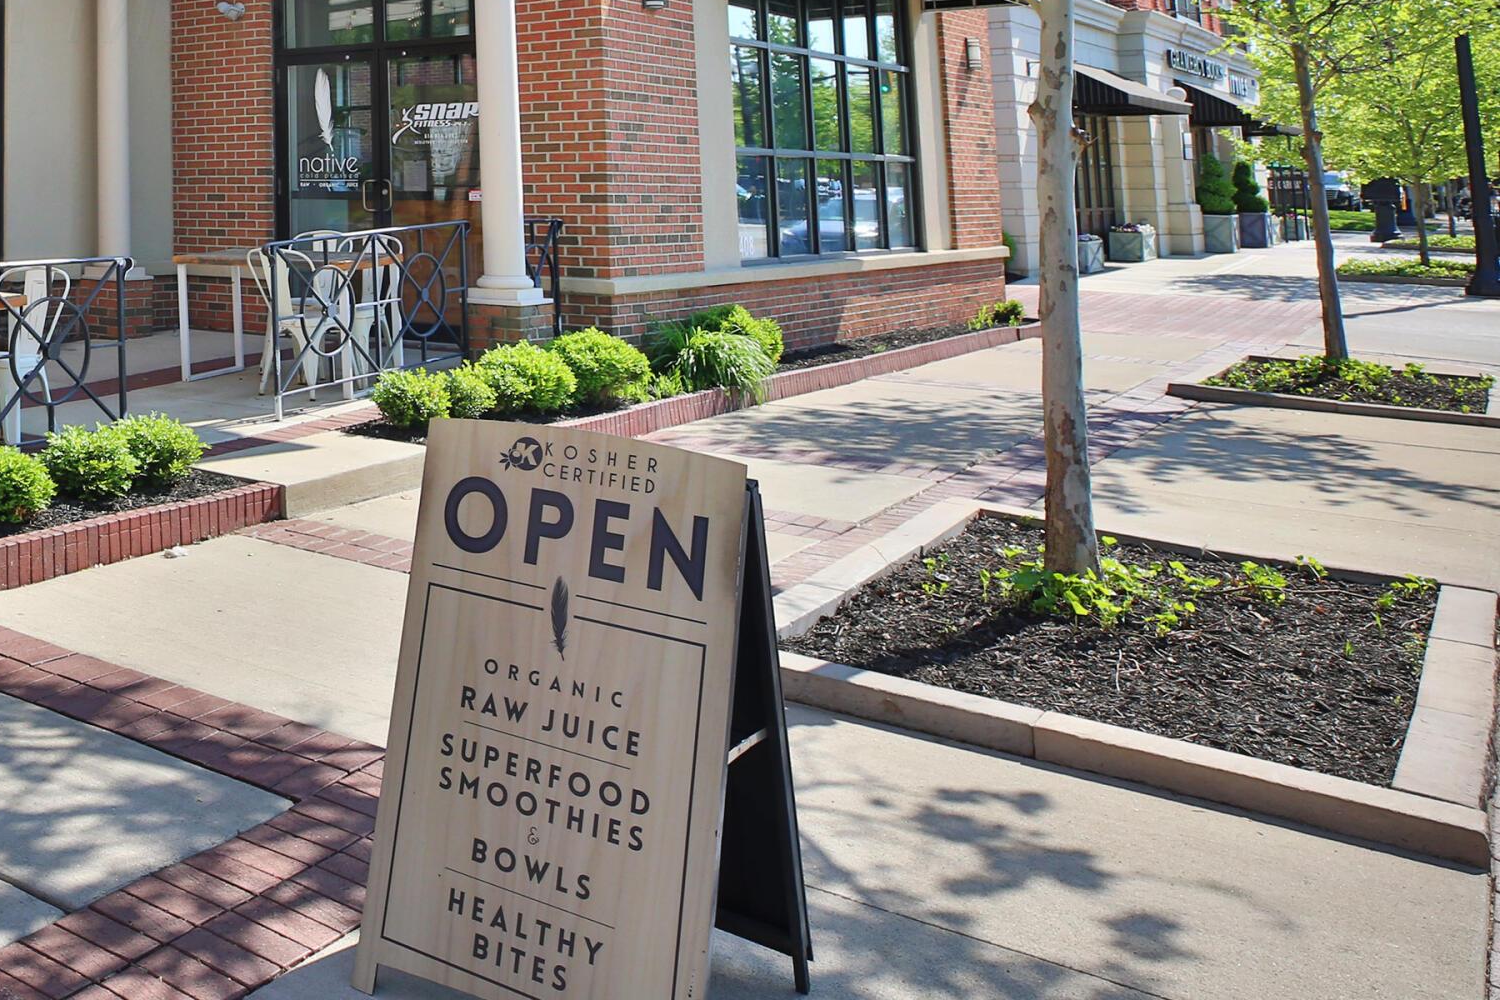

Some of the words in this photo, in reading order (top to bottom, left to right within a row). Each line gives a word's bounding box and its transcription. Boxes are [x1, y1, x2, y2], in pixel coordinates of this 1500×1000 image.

[414, 119, 452, 128] FITNESS
[300, 153, 358, 173] native
[543, 463, 656, 494] CERTIFIED
[545, 442, 658, 473] KOSHER
[444, 476, 709, 602] OPEN
[484, 658, 624, 708] ORGANIC
[460, 686, 528, 723] RAW
[541, 711, 640, 757] JUICE
[441, 733, 651, 816] SUPERFOOD
[438, 766, 644, 852] SMOOTHIES
[527, 826, 540, 846] &
[471, 838, 591, 900] BOWLS
[448, 887, 604, 966] HEALTHY
[472, 935, 567, 992] BITES
